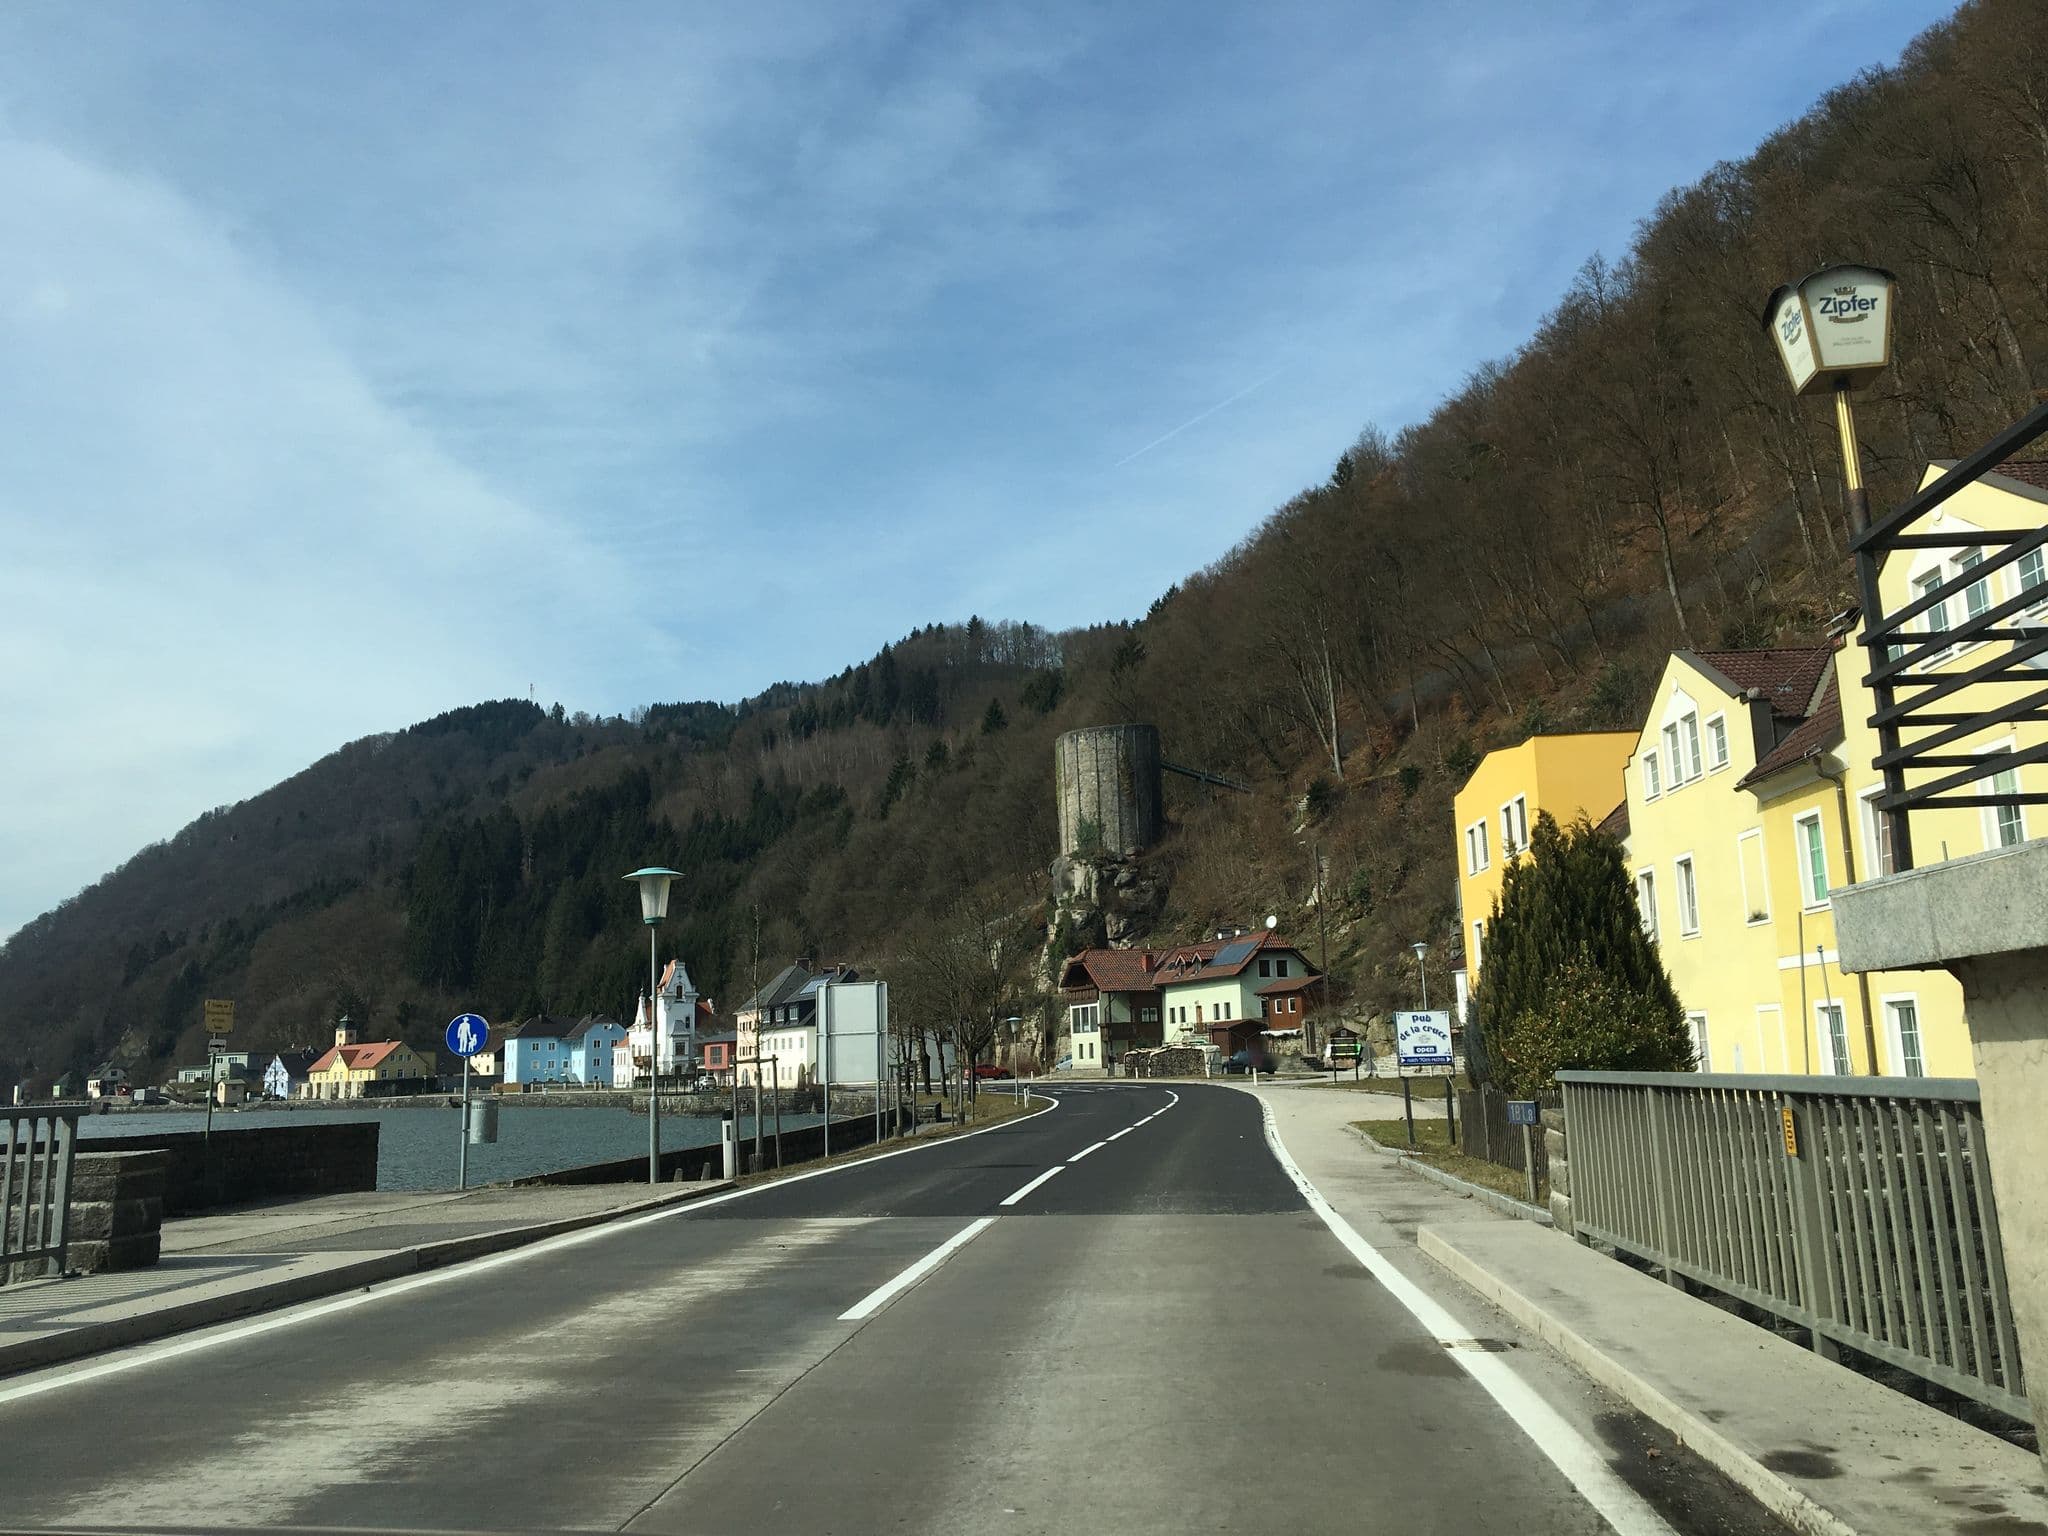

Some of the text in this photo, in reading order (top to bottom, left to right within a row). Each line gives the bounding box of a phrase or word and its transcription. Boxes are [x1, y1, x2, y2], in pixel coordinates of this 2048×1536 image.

[1819, 294, 1878, 316] Zipfer
[1400, 1030, 1410, 1041] de
[1410, 1026, 1420, 1034] la
